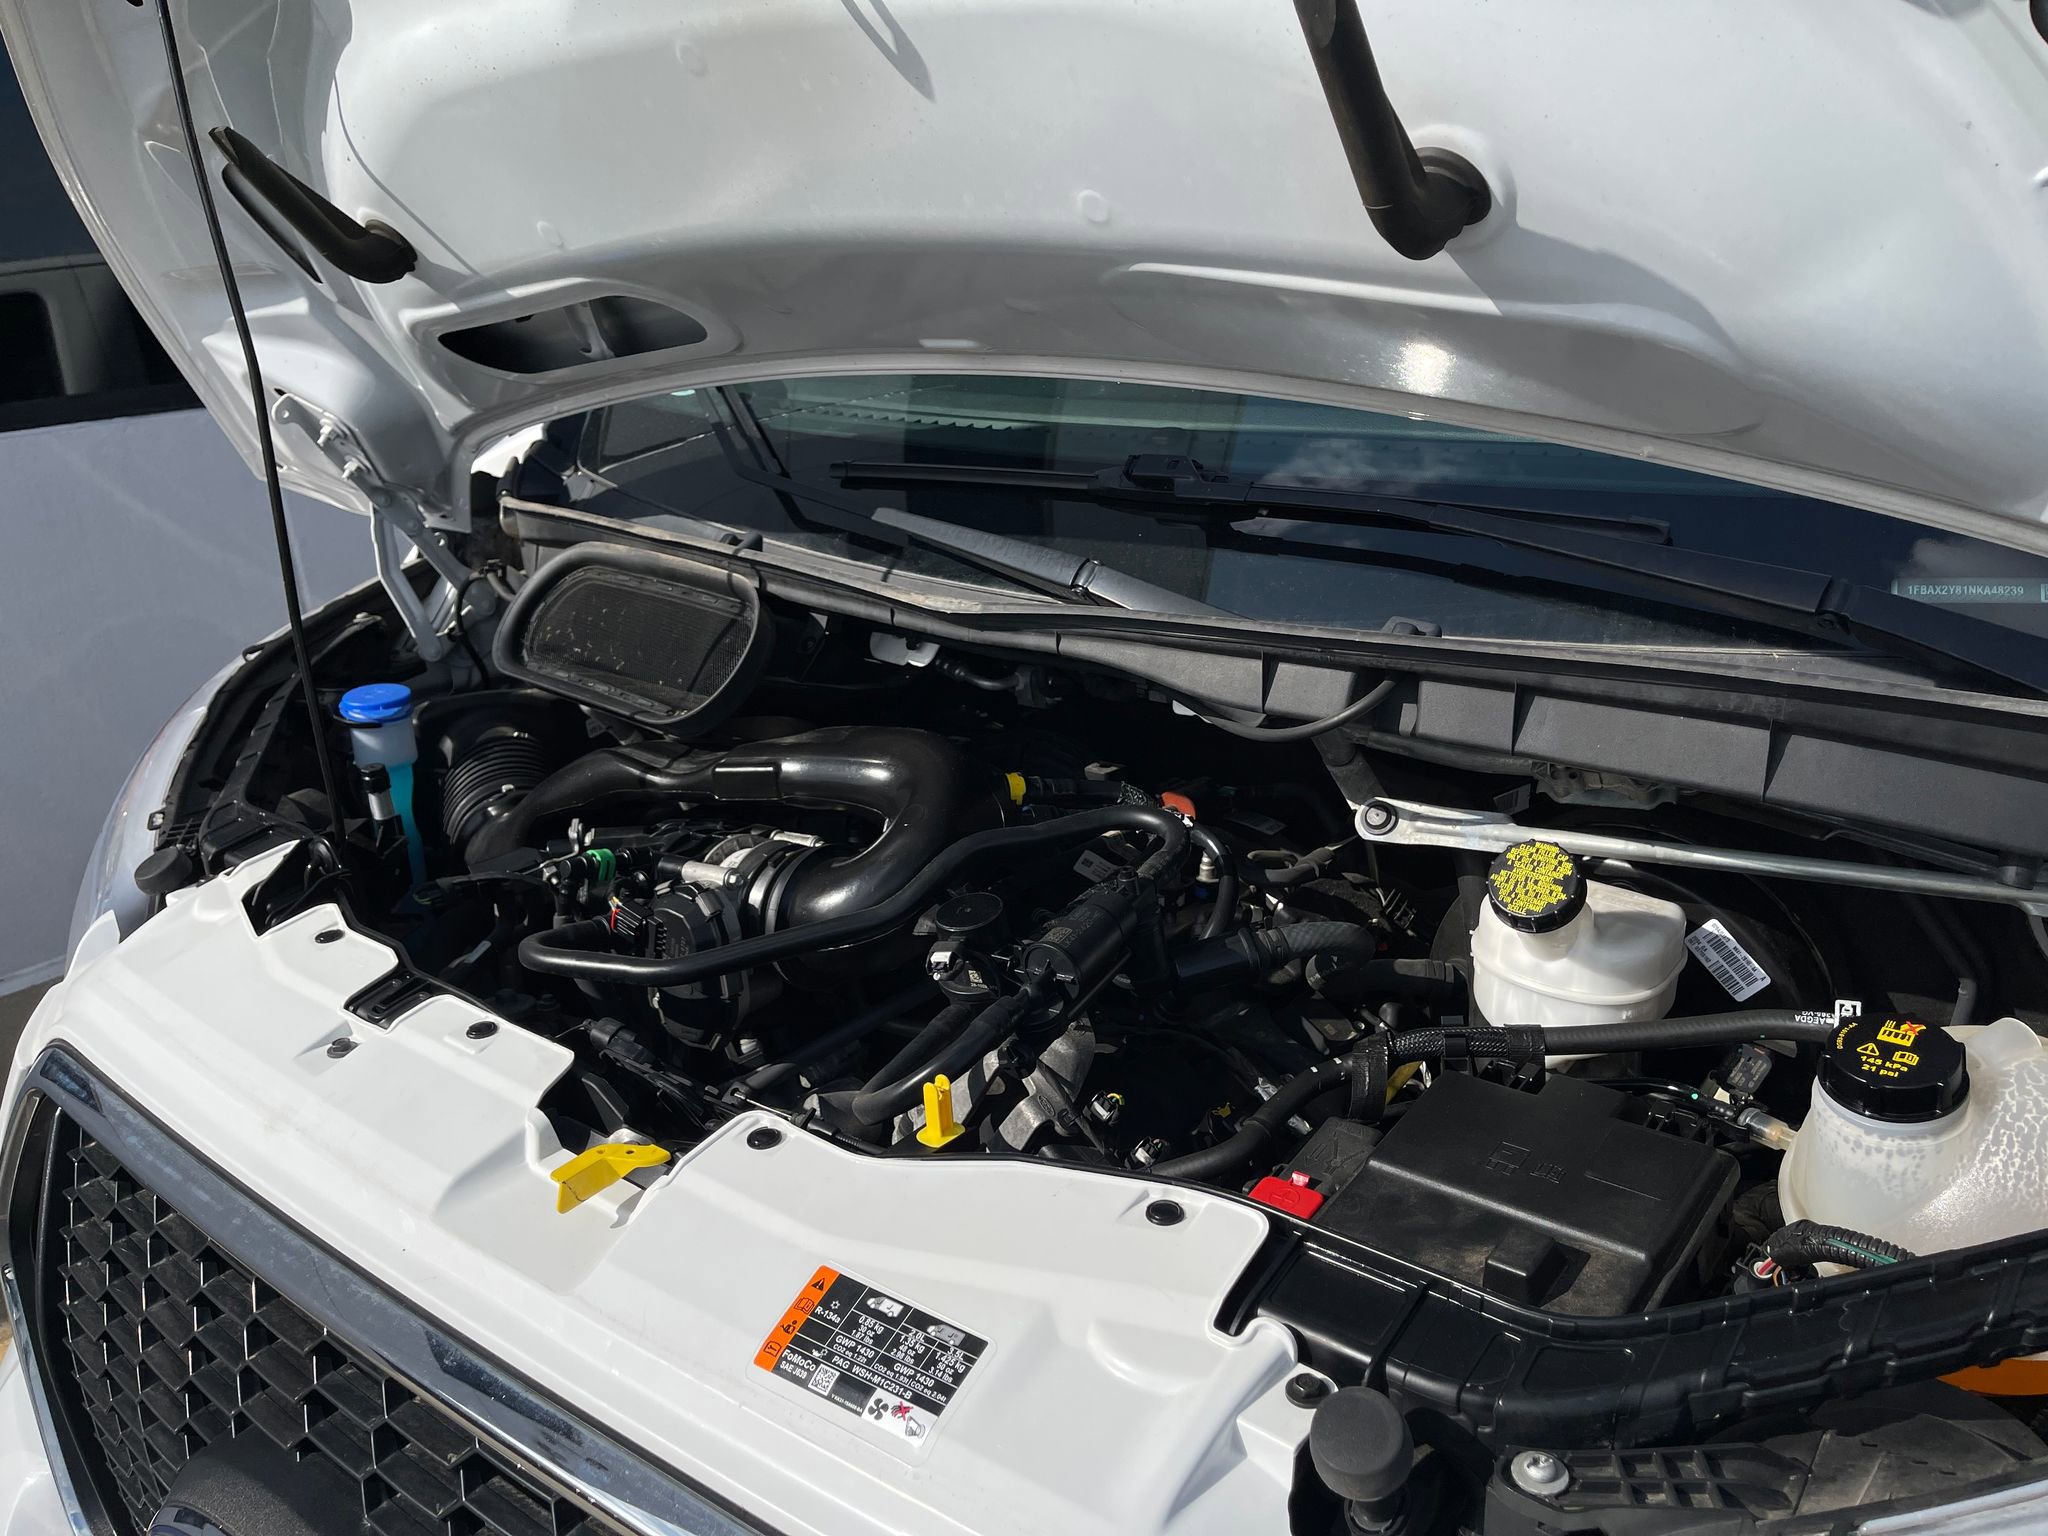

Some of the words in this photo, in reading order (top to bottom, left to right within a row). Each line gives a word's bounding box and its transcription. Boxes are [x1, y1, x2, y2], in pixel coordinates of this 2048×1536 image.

[1908, 585, 2024, 596] 1FBAX2Y81NKA48239
[1860, 1055, 1882, 1066] 145
[1884, 1061, 1908, 1072] kPa
[1861, 1063, 1876, 1072] 21
[1878, 1069, 1899, 1078] psi
[815, 1306, 840, 1323] R-134a
[859, 1315, 875, 1328] 0.85
[874, 1322, 885, 1334] kg
[851, 1330, 864, 1339] 1.87
[863, 1335, 873, 1344] lbs
[908, 1329, 925, 1342] 2.0L
[833, 1344, 846, 1353] CO2
[836, 1335, 856, 1348] GWP
[856, 1345, 874, 1358] 1430
[900, 1335, 916, 1347] 1.35
[914, 1342, 925, 1354] kg
[782, 1349, 816, 1371] FoMoCo
[904, 1355, 914, 1364] lbs
[947, 1347, 963, 1361] 3.5L
[780, 1361, 794, 1372] SAE
[936, 1352, 956, 1366] 1.425
[955, 1361, 966, 1373] kg
[832, 1356, 850, 1369] PAG
[852, 1365, 912, 1399] WSH-M1C231-B
[874, 1363, 887, 1373] CO2
[885, 1370, 894, 1378] eq
[894, 1363, 914, 1376] GWP
[916, 1373, 934, 1387] 1430
[929, 1366, 943, 1377] 3.14
[942, 1373, 953, 1383] lbs
[945, 1367, 954, 1375] oz
[911, 1381, 924, 1391] CO2
[922, 1388, 931, 1396] eq
